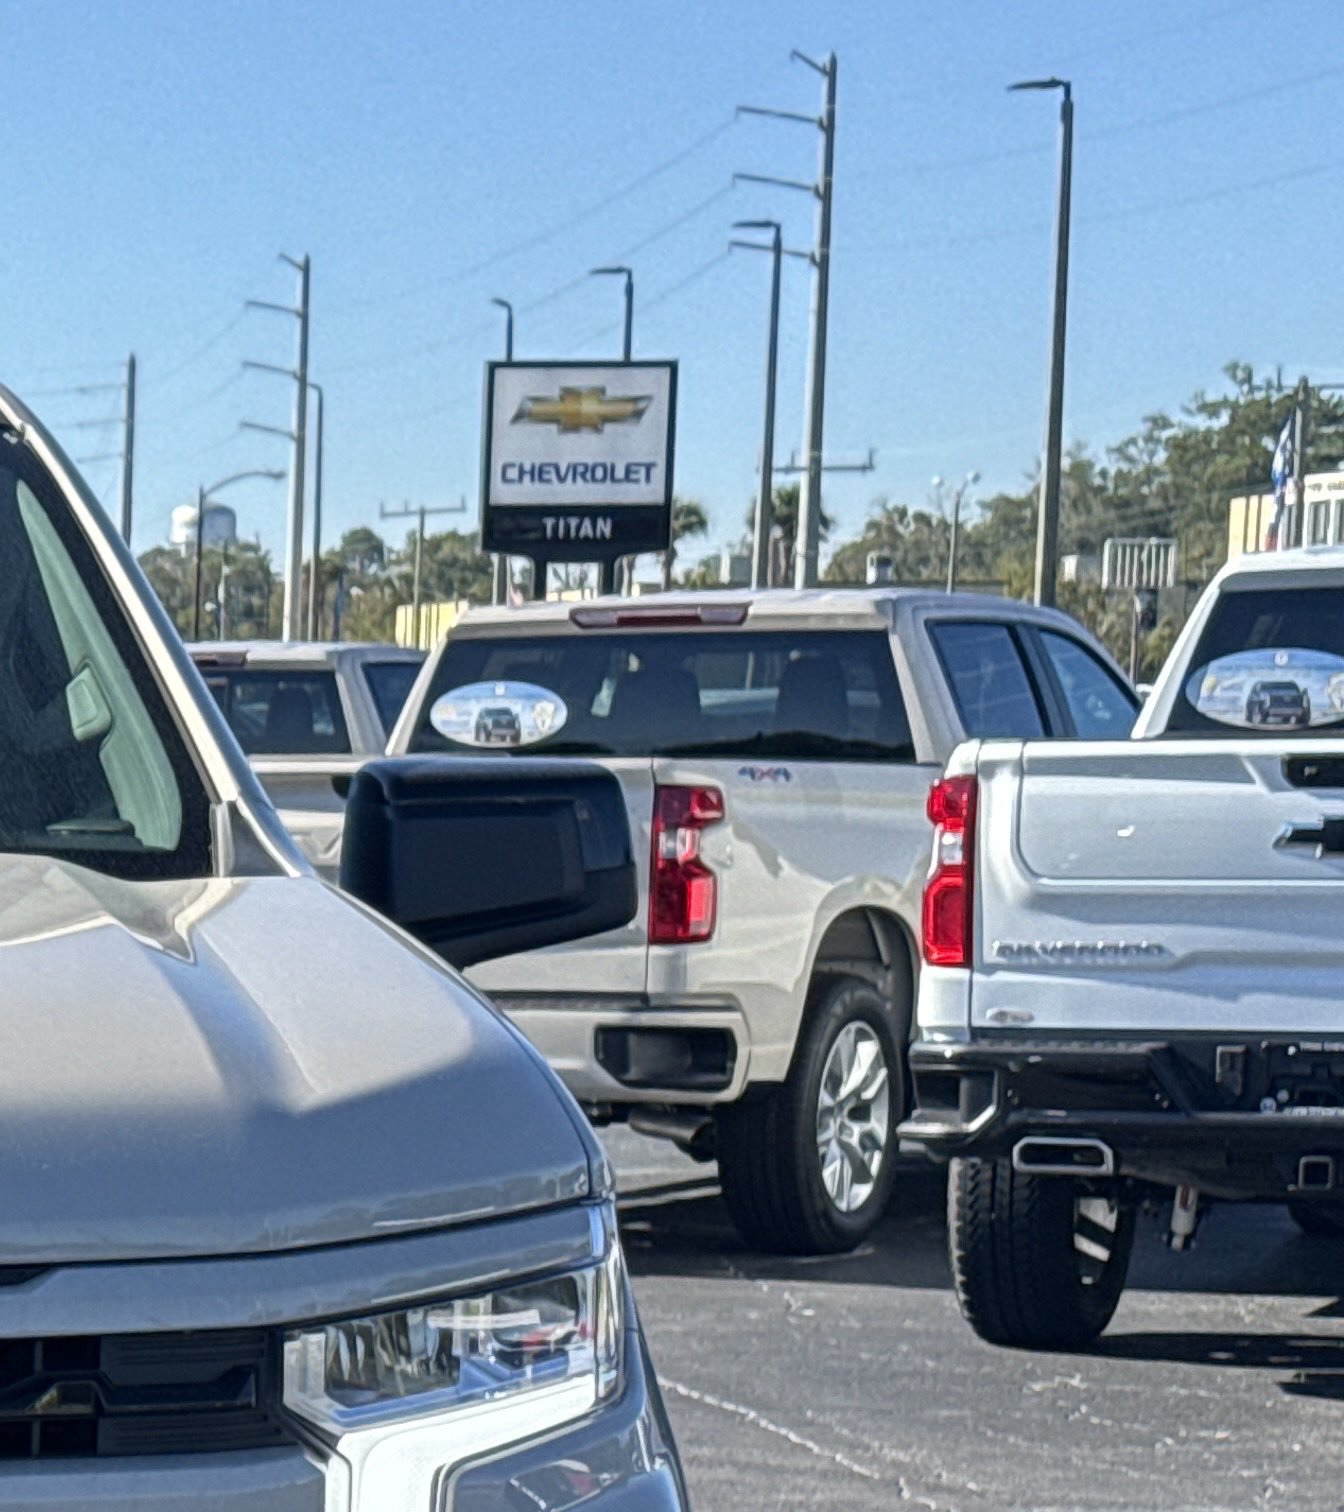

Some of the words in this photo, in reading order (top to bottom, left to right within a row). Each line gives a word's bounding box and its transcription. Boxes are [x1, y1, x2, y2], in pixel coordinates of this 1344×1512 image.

[501, 461, 657, 485] CHEVROLET
[542, 516, 613, 540] TITAN
[992, 939, 1169, 964] SILVERADO
